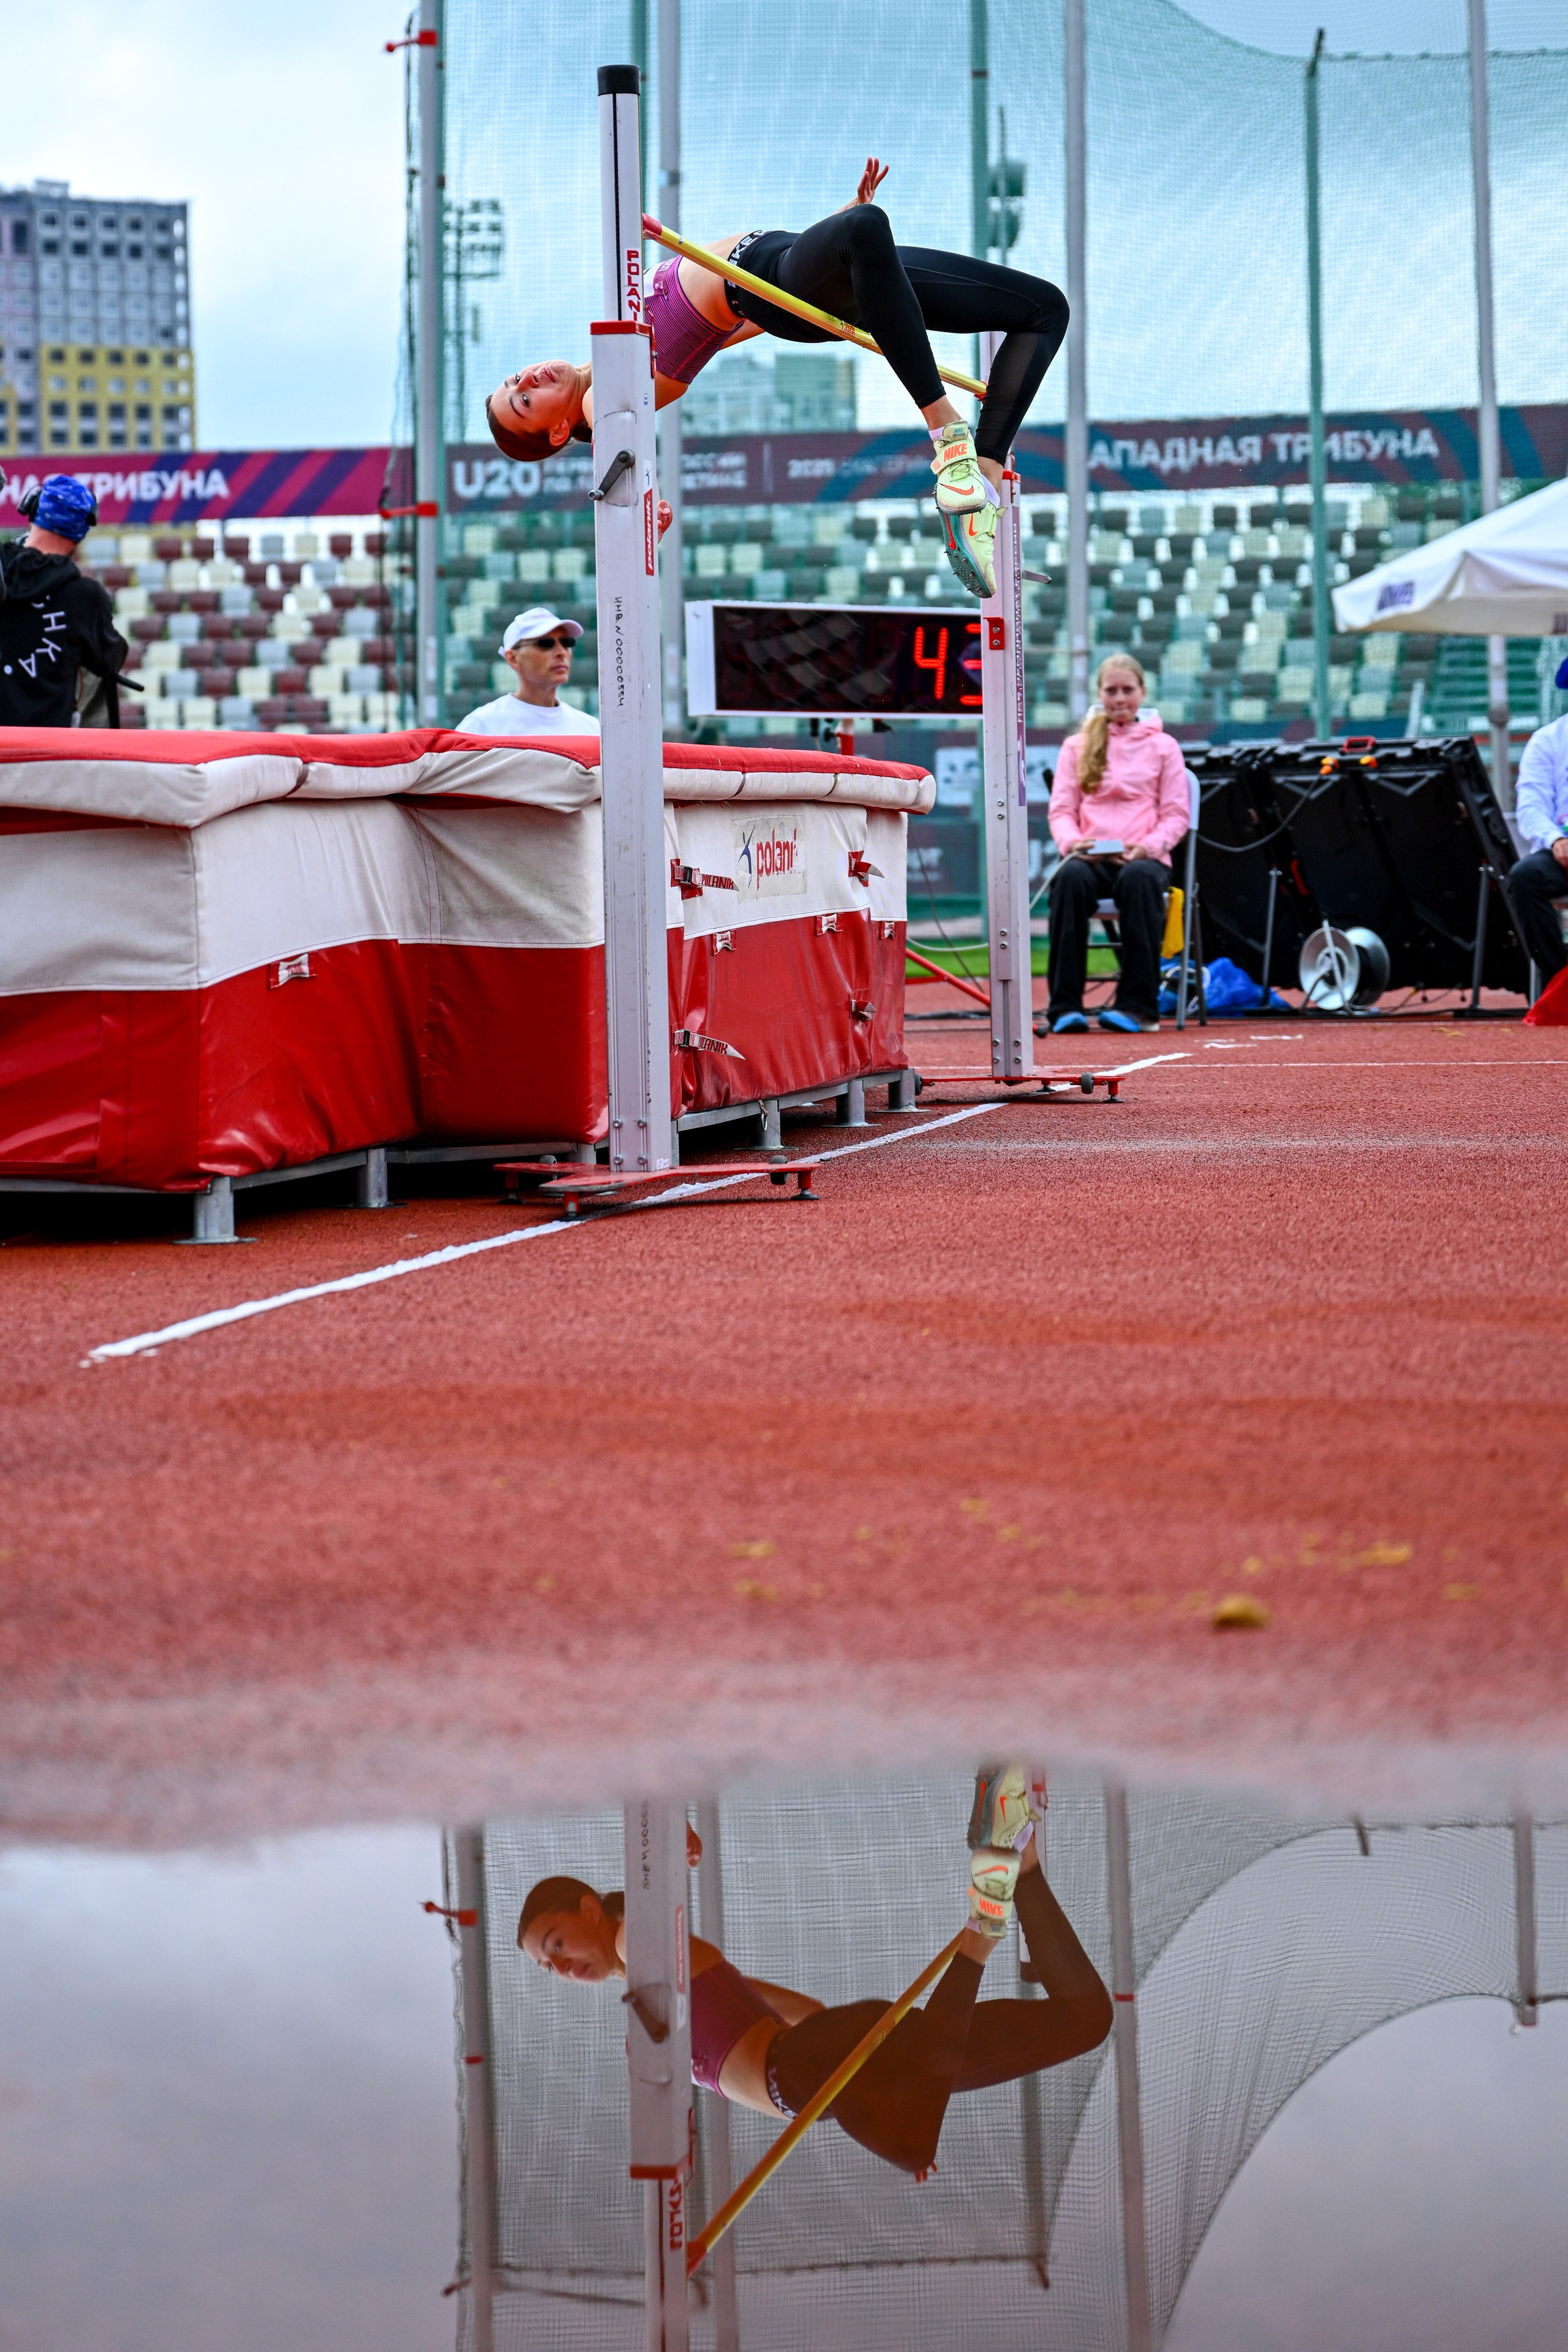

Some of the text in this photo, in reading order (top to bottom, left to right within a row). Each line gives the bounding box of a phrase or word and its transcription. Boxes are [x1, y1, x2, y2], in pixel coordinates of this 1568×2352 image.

[626, 250, 641, 321] POLANI
[943, 443, 968, 463] NIKE
[1088, 434, 1262, 474] АПАДНАЯ
[452, 459, 541, 499] U20
